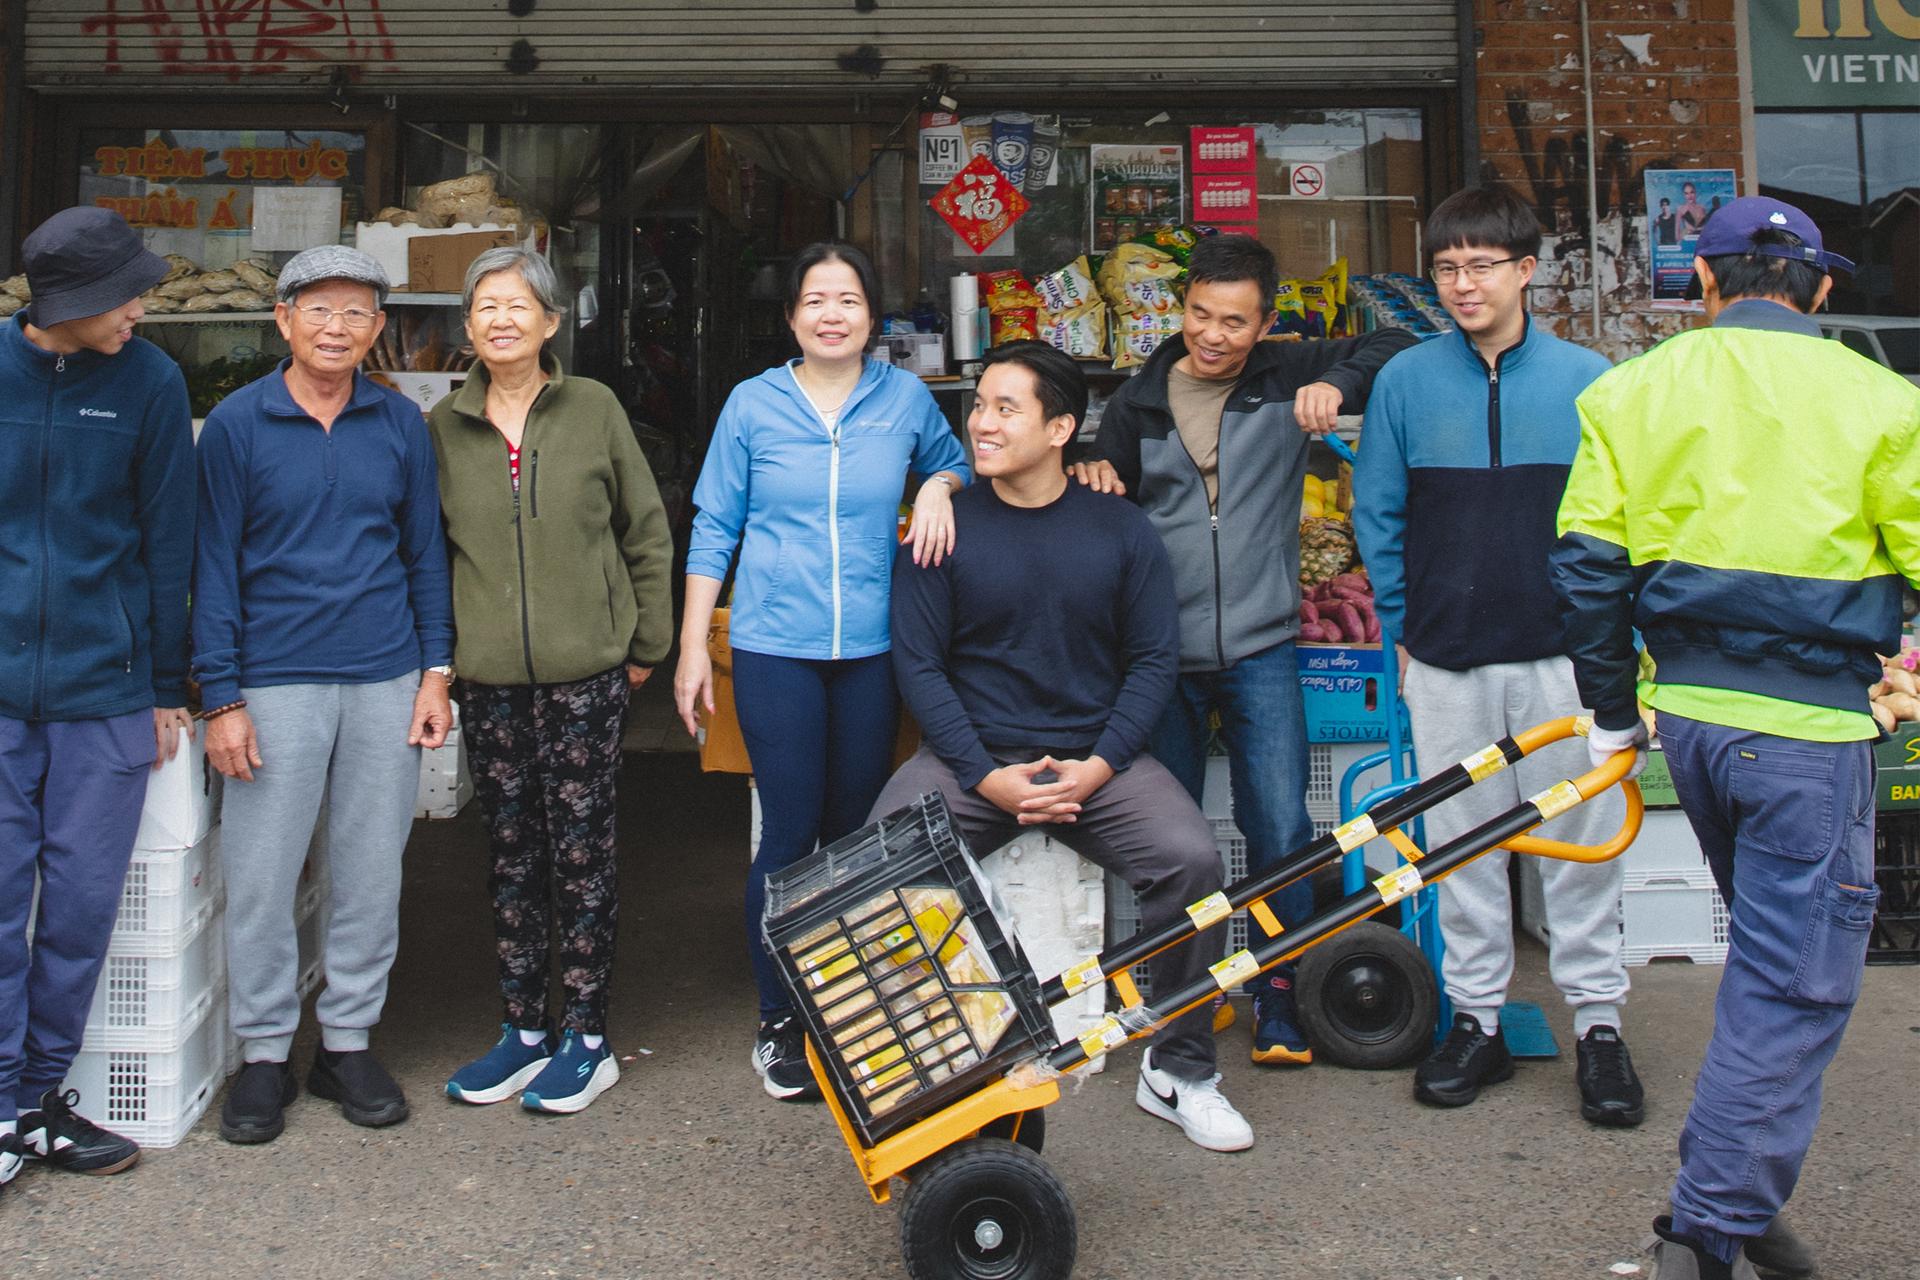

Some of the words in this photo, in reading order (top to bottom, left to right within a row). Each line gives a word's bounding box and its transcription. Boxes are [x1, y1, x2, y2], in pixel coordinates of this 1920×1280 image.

[96, 136, 206, 182] TIỆM
[224, 139, 350, 186] THỰC
[955, 173, 1003, 221] 福
[1063, 270, 1079, 299] Chips
[1071, 320, 1083, 355] Chips
